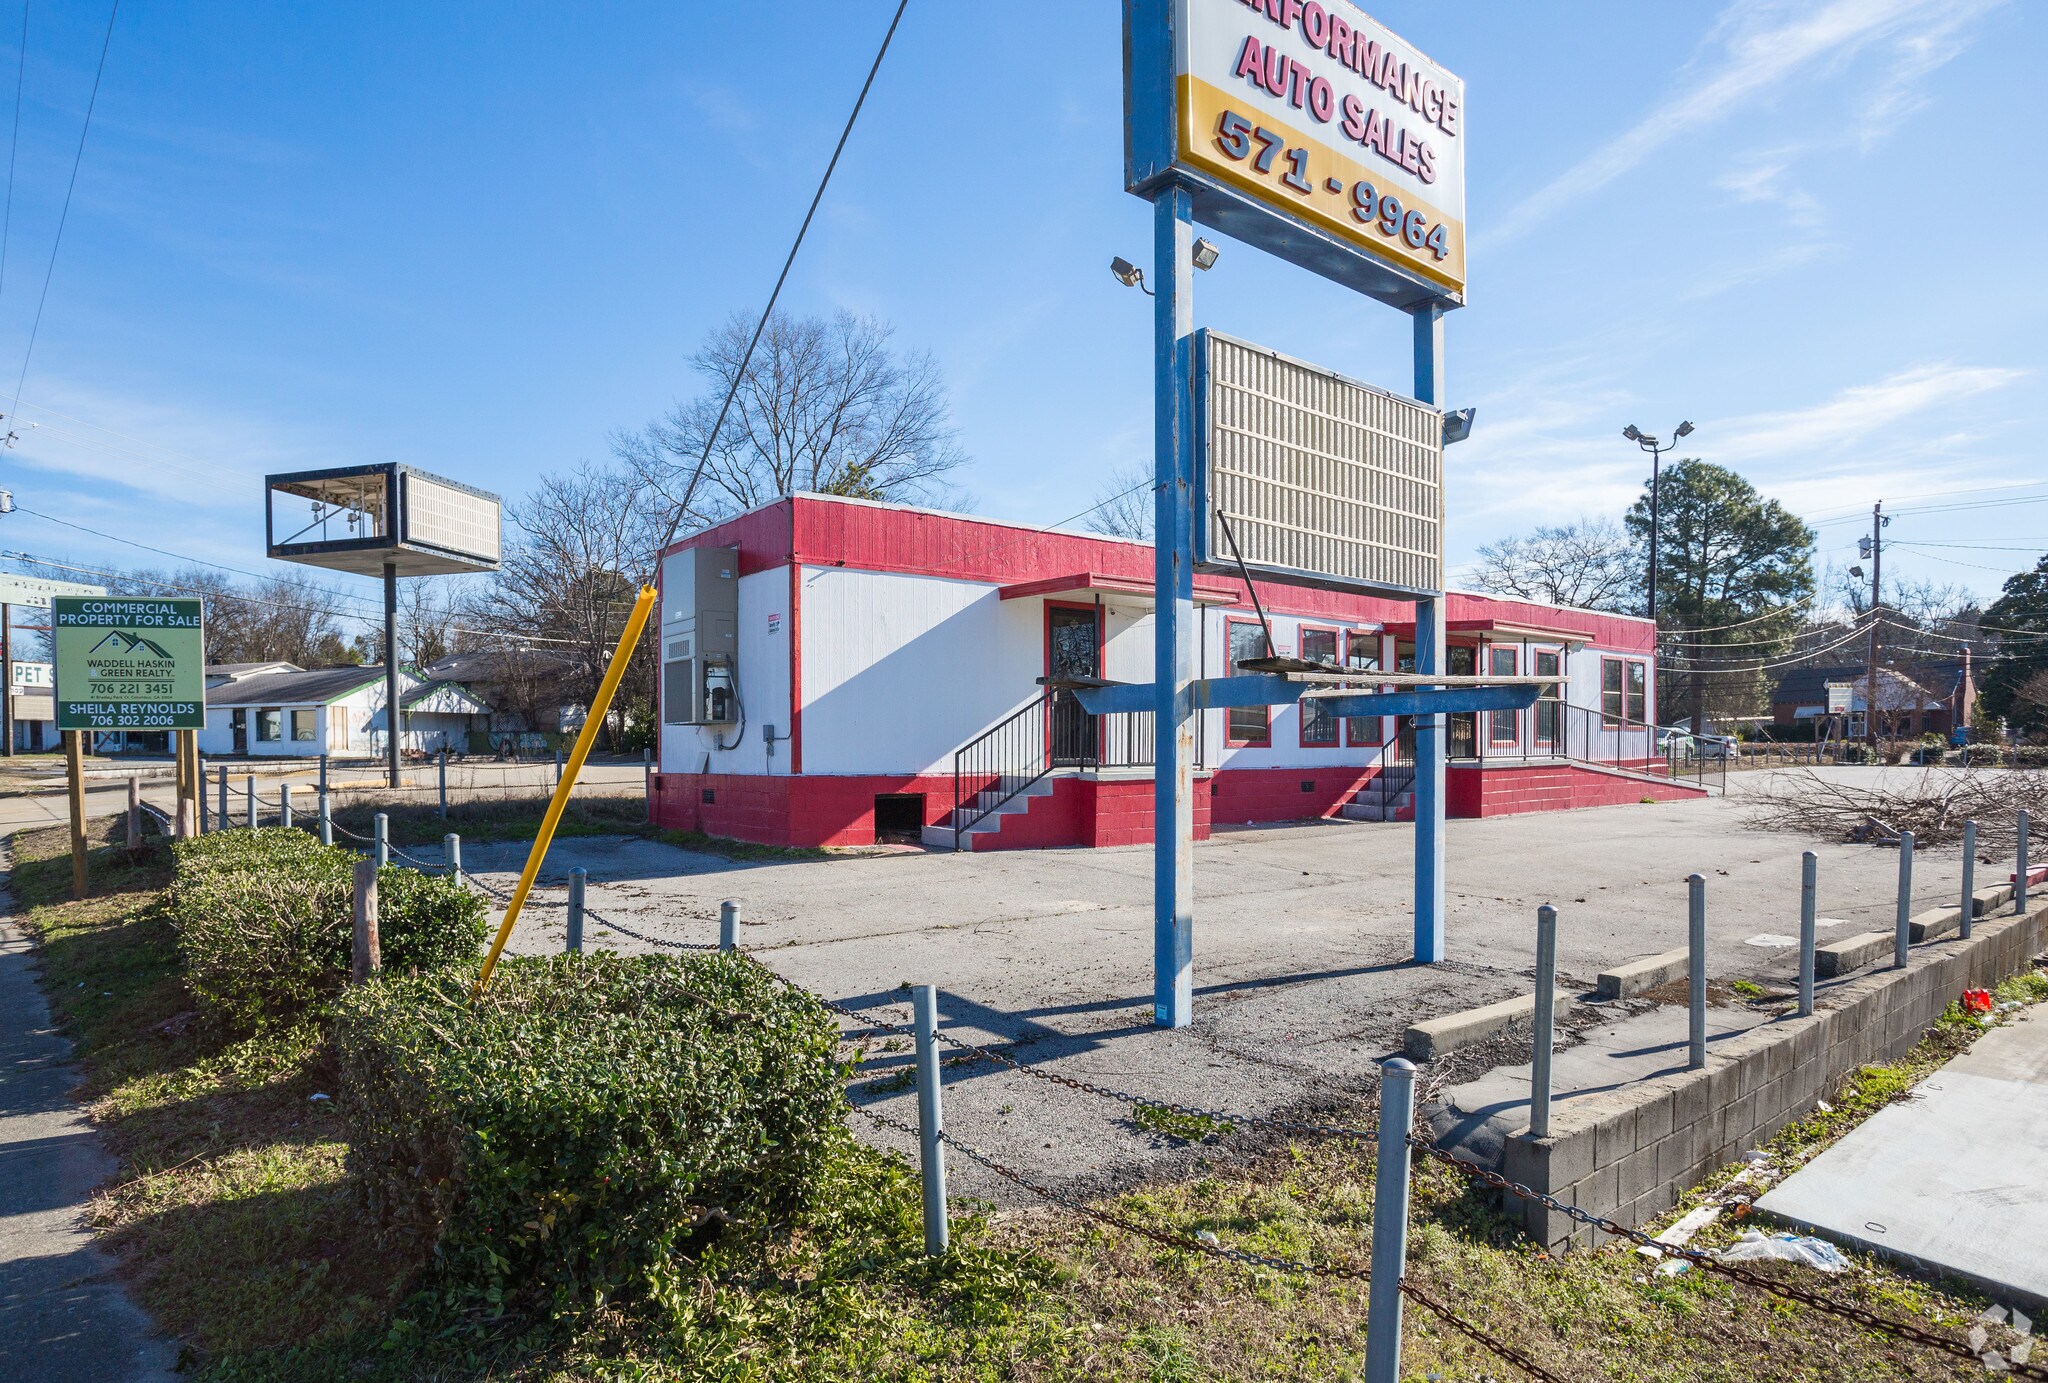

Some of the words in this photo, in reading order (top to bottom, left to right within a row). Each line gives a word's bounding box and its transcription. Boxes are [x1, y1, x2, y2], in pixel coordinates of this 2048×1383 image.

[1233, 0, 1458, 137] FORMANCE
[1236, 35, 1335, 124] AUTO
[1341, 94, 1437, 184] SALES
[1217, 110, 1314, 195] 571
[1352, 180, 1449, 261] 9964
[82, 602, 177, 614] COMMERCIAL
[59, 614, 131, 625] PROPERTY
[135, 615, 164, 625] FOR
[168, 615, 200, 626] SALE
[87, 659, 135, 668] WADDELL
[138, 660, 175, 668] HASKIN
[15, 666, 42, 682] PET
[90, 669, 97, 677] &
[100, 669, 133, 677] GREEN
[90, 684, 114, 694] 706
[119, 684, 140, 694] 221
[145, 684, 173, 694] 3451
[69, 703, 117, 714] SHEILA
[121, 703, 195, 714] REYNOLDS
[91, 715, 114, 726] 706
[117, 715, 140, 726] 302
[143, 715, 174, 726] 2006
